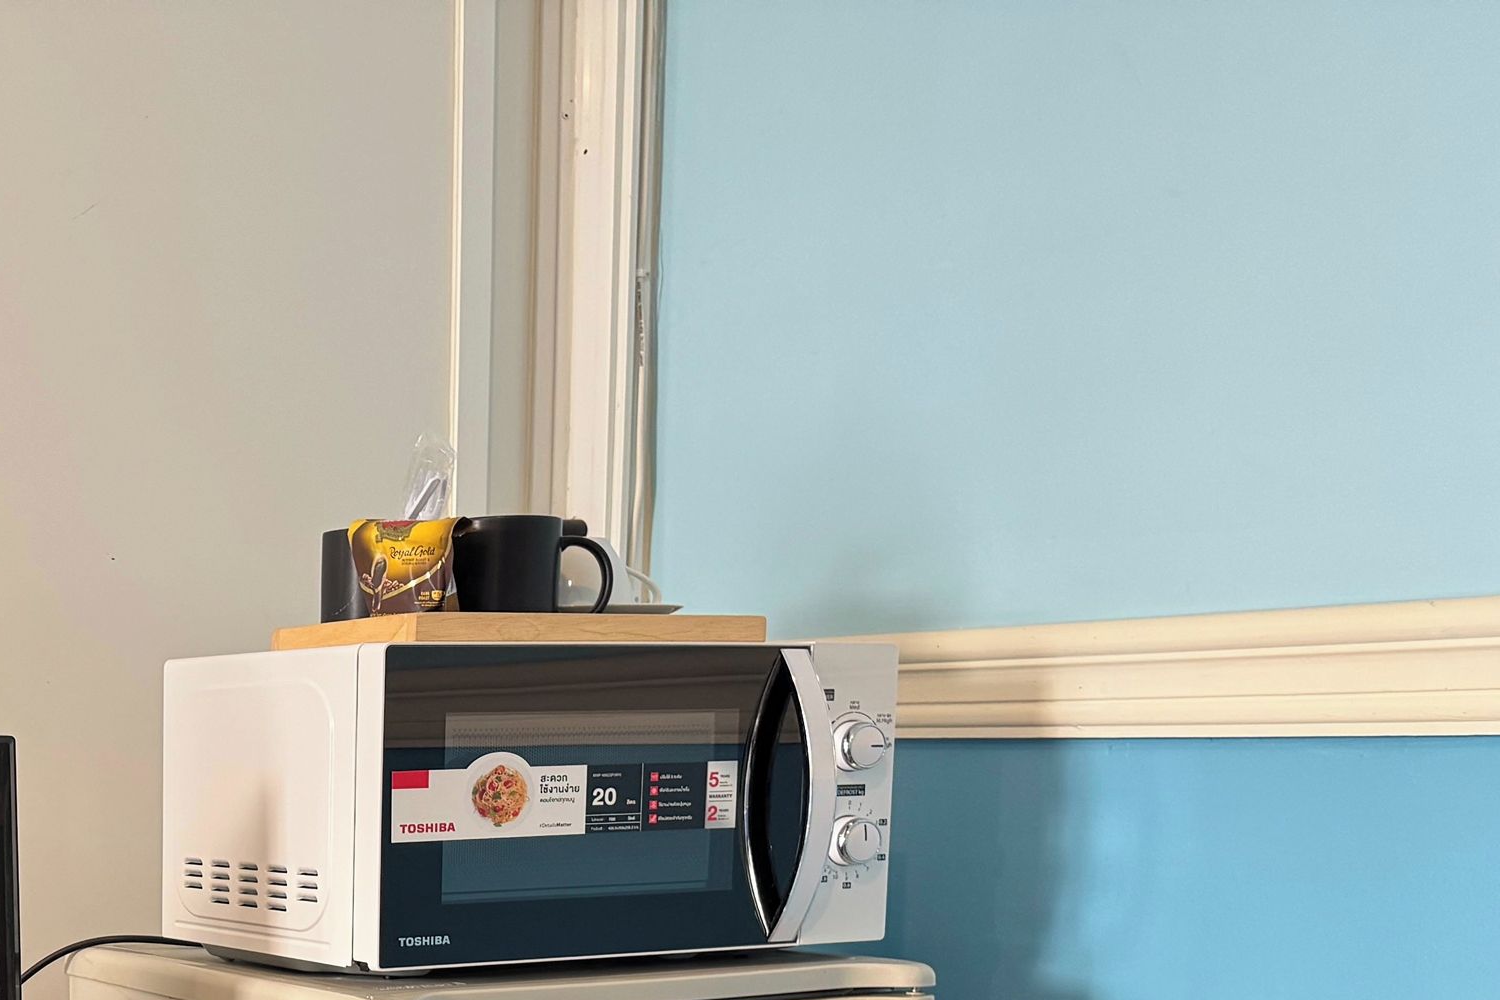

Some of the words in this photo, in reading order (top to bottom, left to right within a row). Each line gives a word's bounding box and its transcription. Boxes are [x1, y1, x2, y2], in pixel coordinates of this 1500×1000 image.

[389, 546, 415, 560] Royal
[414, 545, 436, 557] Gold
[709, 772, 719, 787] 5
[592, 787, 617, 806] 20
[707, 805, 718, 821] 2
[400, 822, 456, 834] TOSHIBA
[398, 935, 451, 947] TOSHIBA
